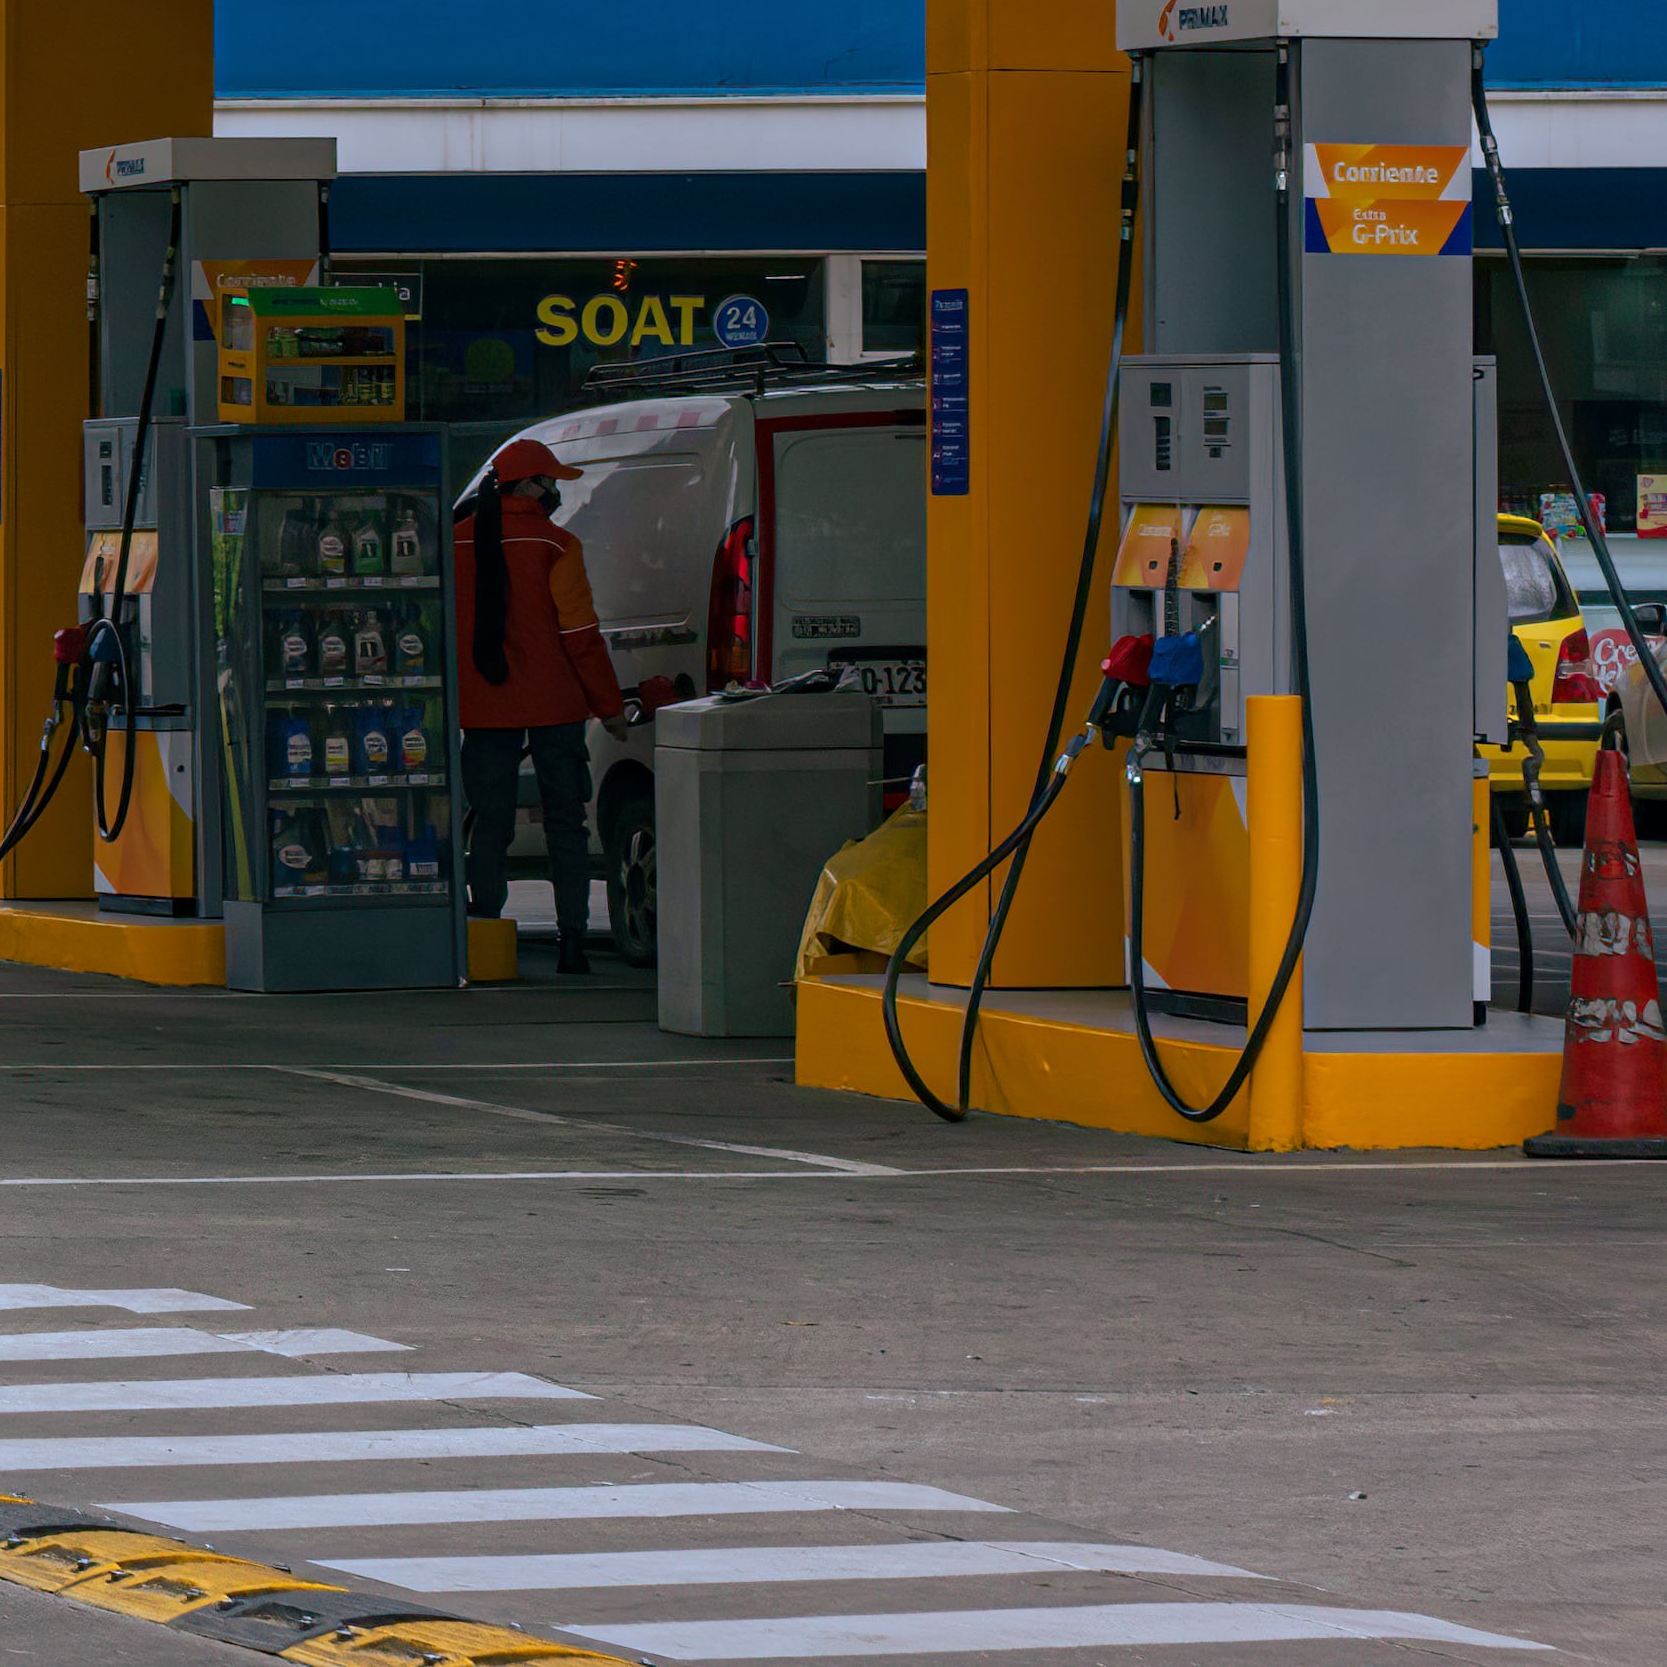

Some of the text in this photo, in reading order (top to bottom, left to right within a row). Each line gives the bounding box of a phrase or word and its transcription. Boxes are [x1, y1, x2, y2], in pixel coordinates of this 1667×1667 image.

[1178, 4, 1228, 31] PRIMAX
[1333, 161, 1439, 184] Corriente
[1352, 223, 1419, 246] G-Prix
[534, 293, 706, 347] SOAT
[726, 305, 757, 330] 24
